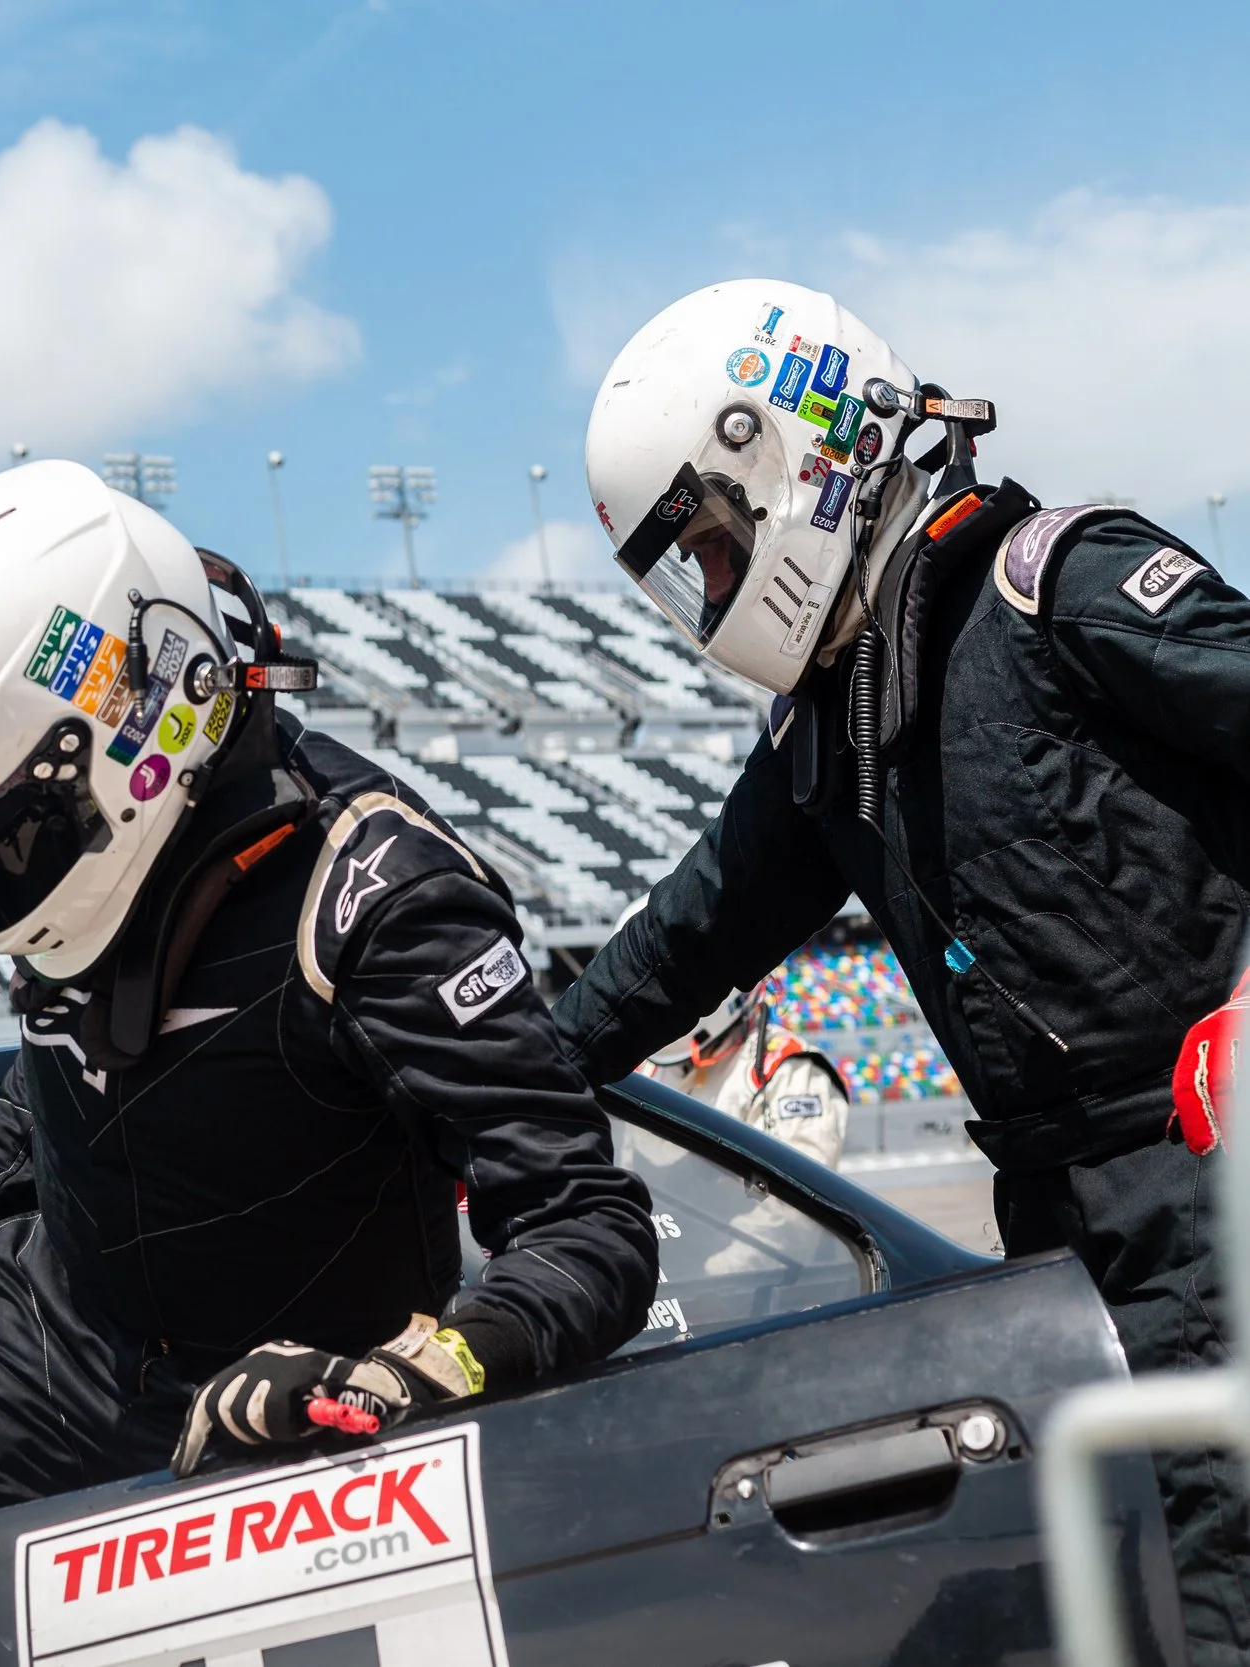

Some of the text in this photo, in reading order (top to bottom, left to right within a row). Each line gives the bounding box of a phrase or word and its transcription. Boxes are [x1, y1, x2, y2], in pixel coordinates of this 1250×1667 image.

[754, 334, 776, 346] 2019
[784, 362, 801, 395] ChampCar
[825, 352, 840, 385] ChampCar
[771, 395, 795, 411] 2018
[799, 392, 813, 415] 2017
[838, 400, 855, 437] ChampCar
[824, 446, 846, 462] 2020
[825, 478, 843, 513] ChampCar
[813, 514, 837, 530] 2023
[1144, 566, 1170, 593] sfi
[163, 640, 187, 683] 2023
[210, 698, 233, 739] 2024
[121, 724, 147, 744] 2023
[179, 721, 194, 746] 2021
[459, 973, 487, 1002] sfi
[53, 1462, 450, 1603] TIRE RACK
[305, 1529, 410, 1575] .com
